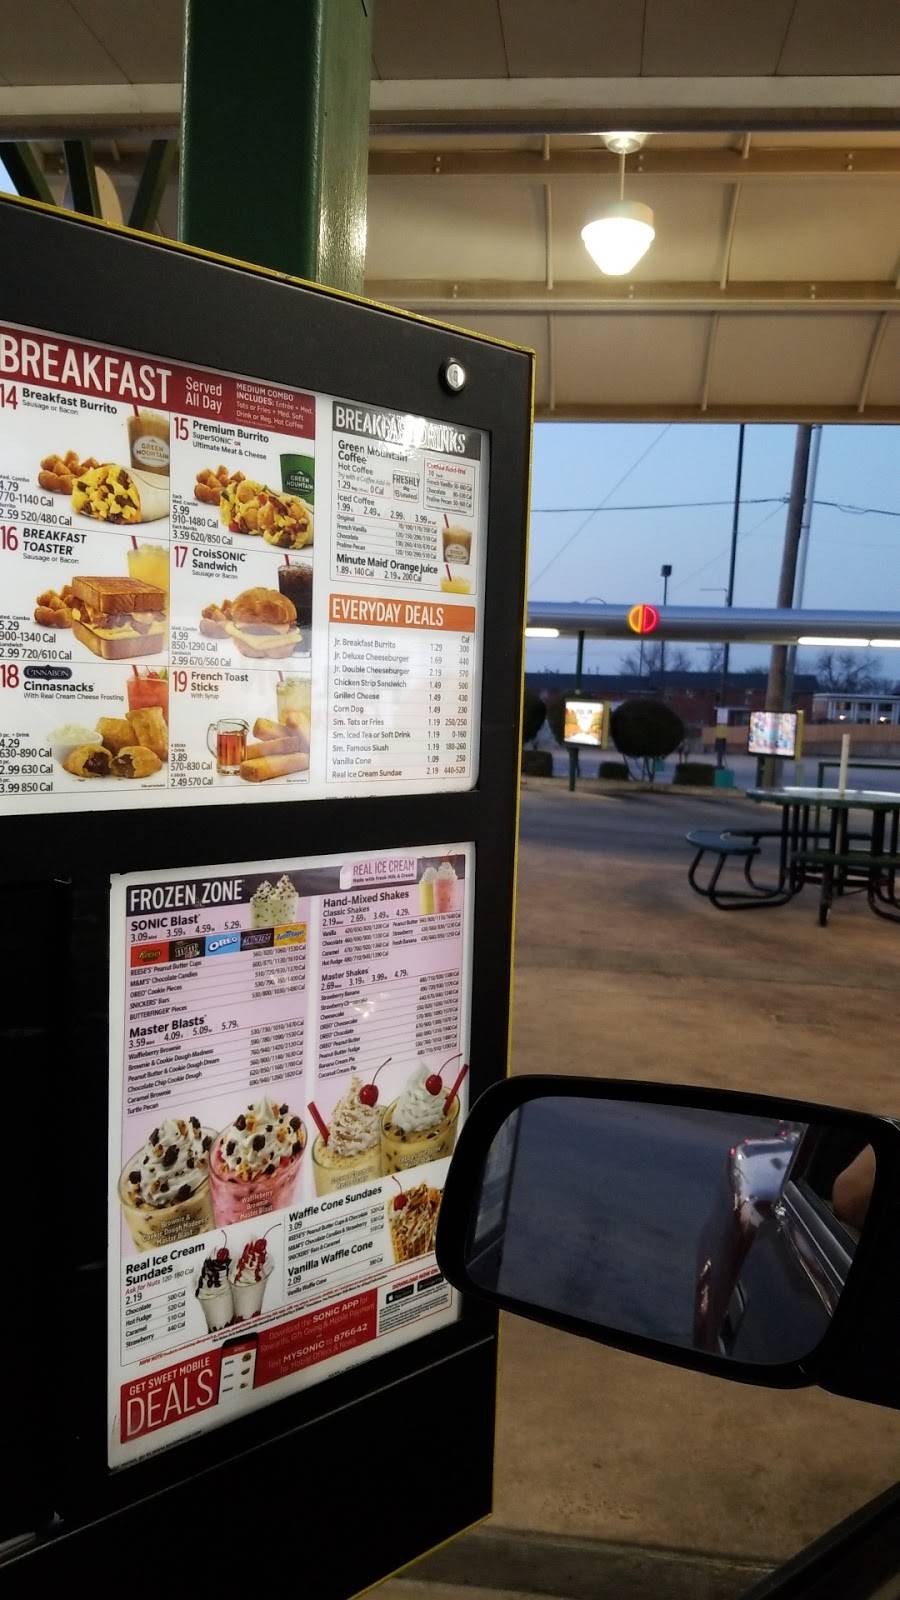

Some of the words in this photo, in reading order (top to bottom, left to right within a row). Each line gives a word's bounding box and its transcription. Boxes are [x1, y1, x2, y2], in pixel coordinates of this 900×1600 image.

[0, 335, 172, 404] BREAKFAST
[186, 376, 222, 396] Served
[236, 383, 265, 395] MEDIUM
[267, 391, 294, 401] COMBO
[0, 384, 18, 410] 14
[22, 388, 77, 407] Breakfast
[80, 399, 117, 414] Burrito
[186, 392, 199, 406] All
[203, 395, 222, 414] Day
[22, 400, 49, 411] Sausage
[59, 407, 78, 415] Bacon
[257, 406, 271, 414] Fries
[292, 412, 304, 421] Soft
[174, 417, 188, 441] 15
[193, 421, 235, 436] Premium
[237, 429, 269, 443] Burrito
[335, 406, 416, 447] BREAKFAS
[193, 442, 220, 452] Ultimate
[222, 447, 237, 455] Meat
[245, 451, 266, 460] Cheese
[338, 440, 364, 454] Green
[368, 446, 407, 462] Mountain
[338, 451, 367, 464] Coffee
[338, 462, 350, 471] Hot
[352, 465, 373, 475] Coffee
[0, 482, 18, 492] 4.79
[287, 481, 314, 489] MOUNTAIN
[393, 474, 420, 487] FRESHLY
[0, 491, 38, 505] 770-1140
[41, 497, 53, 507] Cal
[338, 493, 351, 502] Iced
[353, 496, 374, 506] Coffee
[0, 508, 18, 520] 2.59
[21, 511, 57, 525] 520/480
[59, 514, 72, 526] Cal
[173, 505, 189, 515] 5.99
[172, 515, 206, 527] 910-1480
[207, 519, 218, 528] Cal
[0, 526, 18, 551] 16
[23, 528, 87, 544] BREAKFAST
[172, 530, 189, 540] 3.59
[191, 532, 220, 544] 620/850
[222, 536, 233, 545] Cal
[23, 541, 73, 556] TOASTER
[192, 548, 246, 562] CroisSONIC
[23, 553, 50, 562] Sausage
[60, 556, 79, 564] Bacon
[175, 546, 188, 568] 17
[337, 554, 365, 565] Minute
[368, 558, 387, 567] Maid
[390, 560, 418, 573] Orange
[420, 563, 438, 574] Juice
[192, 559, 237, 572] Sandwich
[192, 570, 214, 578] Sausage
[333, 598, 401, 623] EVERYDAY
[405, 604, 444, 626] DEALS
[0, 621, 19, 630] 5.29
[0, 631, 41, 642] 900-1340
[43, 633, 56, 643] Cal
[172, 632, 188, 640] 4.99
[0, 648, 19, 658] 2.99
[22, 649, 57, 660] 720/610
[59, 651, 72, 660] Cal
[172, 641, 205, 651] 850-1290
[207, 643, 217, 652] Cal
[0, 664, 19, 688] 18
[173, 671, 188, 692] 19
[192, 672, 222, 680] French
[224, 672, 248, 682] Toast
[24, 681, 93, 692] Cinnasnacks
[191, 682, 219, 692] Sticks
[377, 680, 406, 688] Sandwich
[351, 705, 364, 714] Dog
[429, 706, 440, 714] 1.49
[381, 730, 393, 738] Soft
[395, 730, 411, 738] Drink
[0, 739, 19, 748] 4.29
[39, 748, 52, 758] Cal
[171, 753, 187, 761] 3.89
[171, 762, 200, 771] 570-830
[202, 761, 212, 770] Cal
[0, 783, 19, 793] 3.99
[22, 783, 38, 792] 850
[40, 782, 53, 792] Cal
[353, 864, 372, 876] REAL
[375, 862, 387, 873] ICE
[389, 859, 415, 873] CREAM
[130, 884, 196, 912] FROZEN
[201, 879, 242, 903] ZONE
[324, 894, 378, 908] Hand-Mixed
[380, 890, 409, 901] Shakes
[323, 907, 345, 917] Classic
[347, 906, 370, 915] Shakes
[131, 918, 167, 932] SONIC
[171, 915, 198, 926] Blast
[209, 936, 238, 951] OREO
[154, 965, 173, 973] Peanut
[322, 972, 344, 981] Master
[346, 968, 368, 978] Shakes
[152, 974, 177, 984] Chocolate
[178, 971, 198, 980] Candies
[130, 1023, 169, 1038] Master
[172, 1015, 205, 1031] Blasts
[289, 1206, 318, 1222] Waffle
[321, 1198, 343, 1211] Cone
[345, 1186, 382, 1204] Sundaes
[126, 1262, 150, 1274] Real
[153, 1255, 168, 1266] Ice
[170, 1243, 205, 1260] Cream
[288, 1259, 319, 1277] Vanilla
[321, 1248, 349, 1264] Waffle
[351, 1241, 373, 1254] Cone
[125, 1264, 173, 1287] Sundaes
[125, 1292, 142, 1306] 2.19
[313, 1307, 340, 1323] SONIC
[341, 1300, 359, 1312] APP
[283, 1341, 325, 1363] MYSONIC
[334, 1323, 368, 1342] 876642
[130, 1381, 147, 1396] GET
[149, 1371, 176, 1389] SWEET
[180, 1357, 210, 1377] MOBILE
[126, 1369, 213, 1437] DEALS
